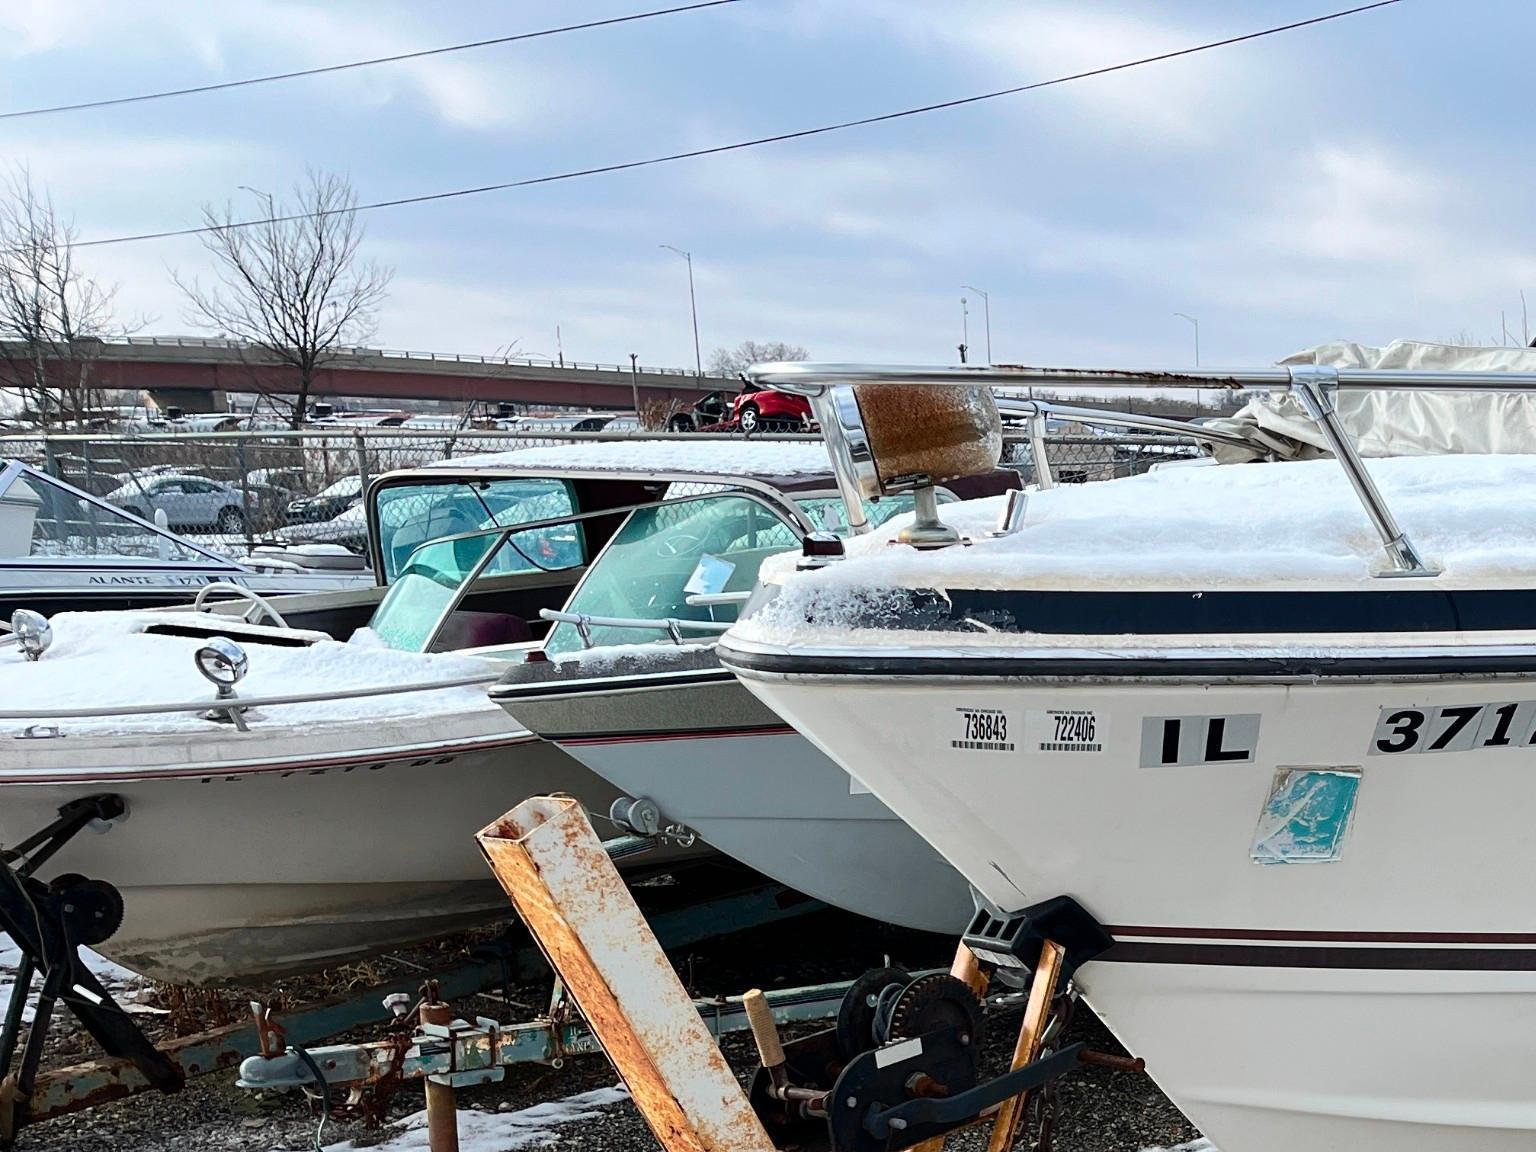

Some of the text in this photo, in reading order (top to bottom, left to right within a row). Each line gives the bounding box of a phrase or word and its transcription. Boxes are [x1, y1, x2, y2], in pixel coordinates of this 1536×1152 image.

[89, 576, 153, 585] ALANTE
[964, 713, 1007, 741] 736843
[1054, 716, 1095, 741] 722406
[1161, 718, 1249, 763] IL
